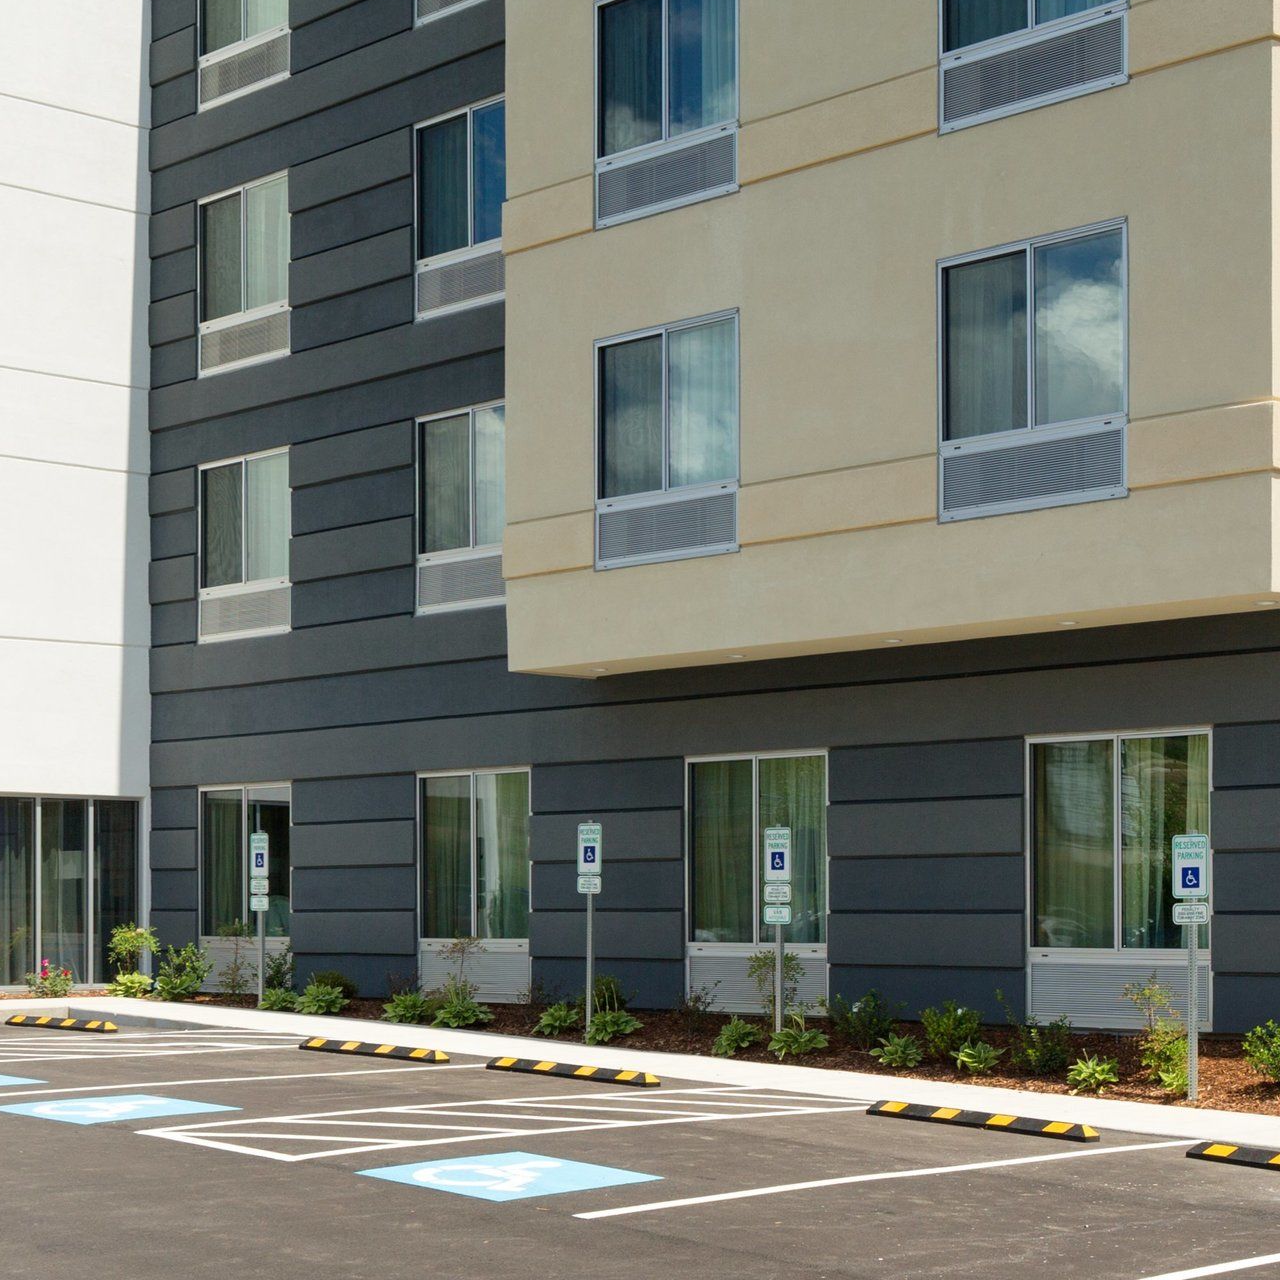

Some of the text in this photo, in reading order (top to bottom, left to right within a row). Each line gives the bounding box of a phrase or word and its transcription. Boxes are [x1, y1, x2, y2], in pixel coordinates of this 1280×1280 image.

[767, 832, 789, 840] RESERVED
[768, 842, 788, 850] PARKING
[1175, 840, 1206, 850] RESERVED
[1177, 851, 1204, 860] PARKING
